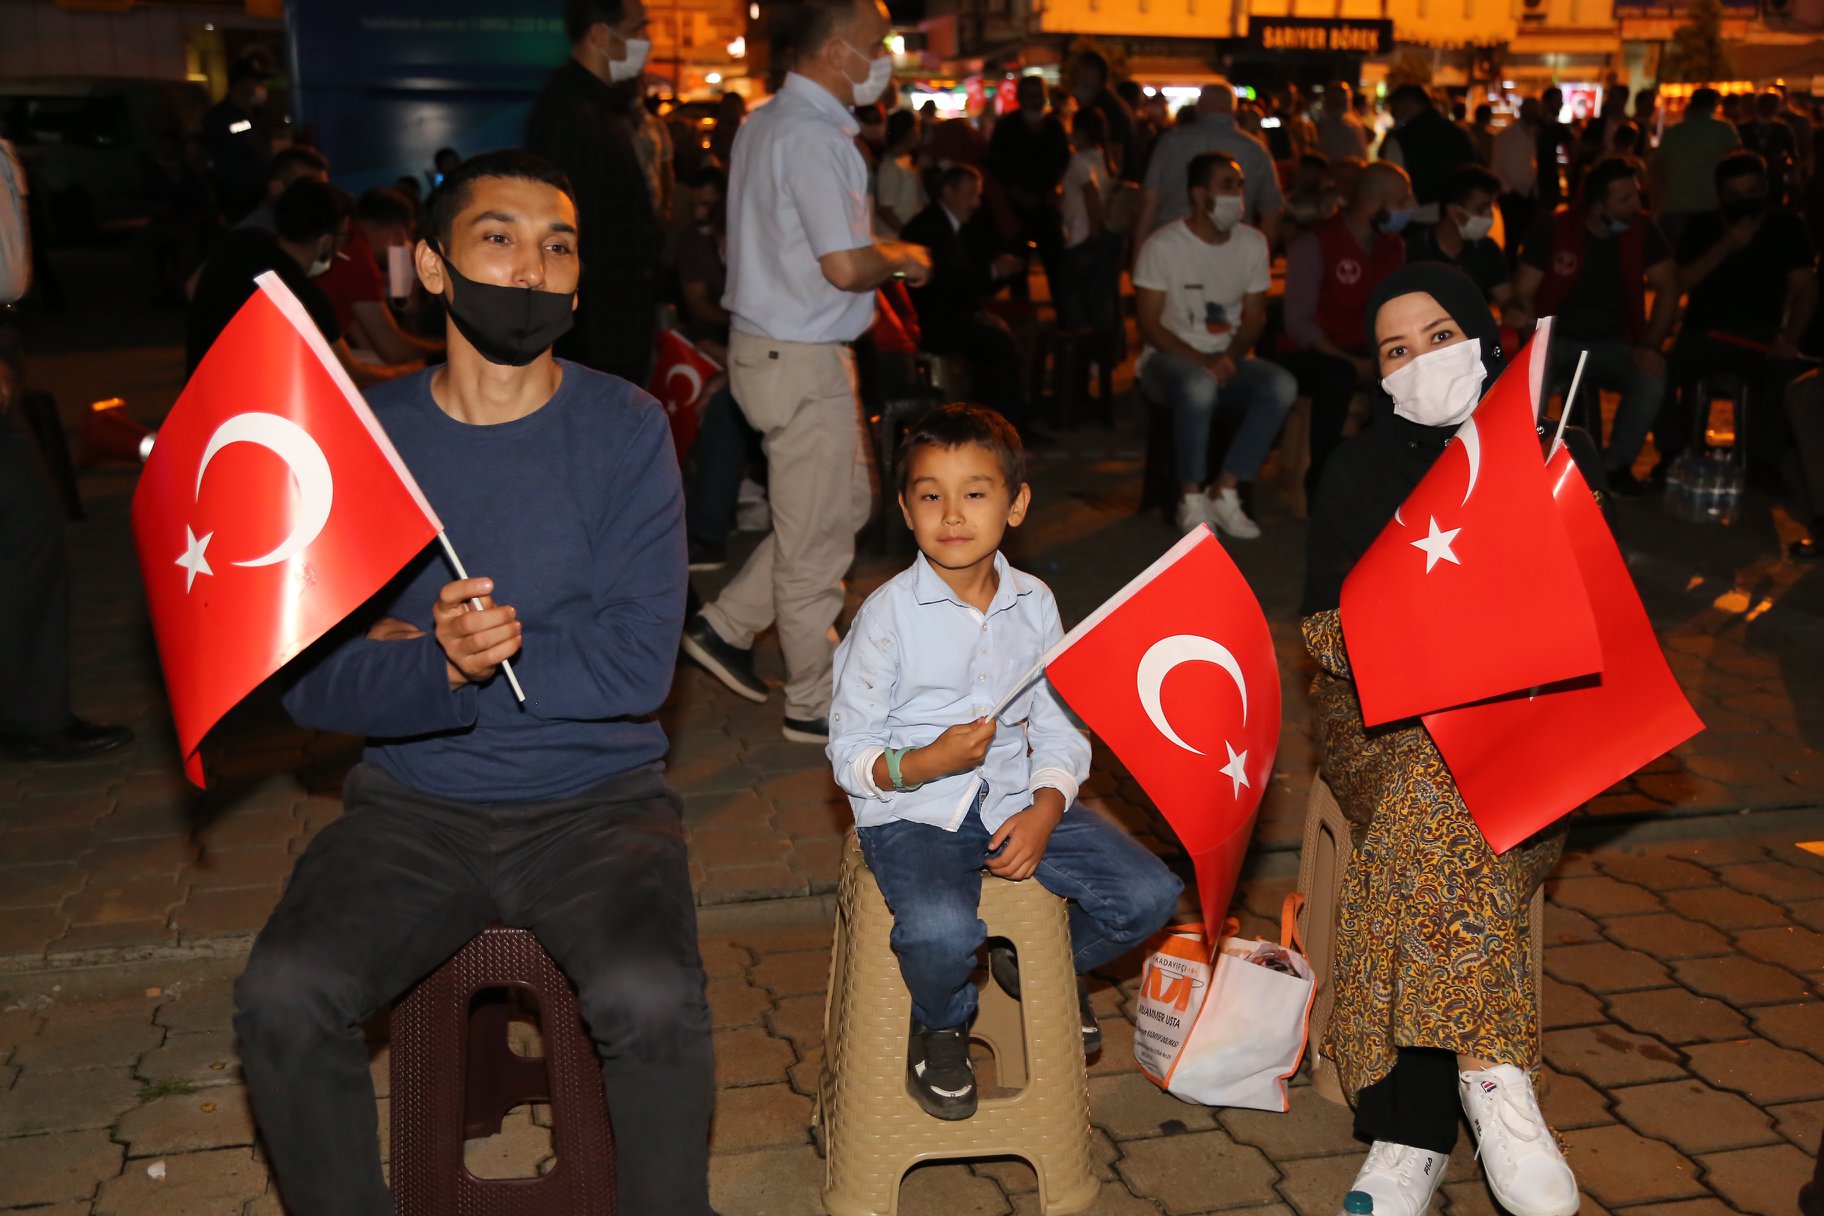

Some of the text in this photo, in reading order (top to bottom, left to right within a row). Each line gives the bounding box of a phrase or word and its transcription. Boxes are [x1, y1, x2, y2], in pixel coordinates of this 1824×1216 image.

[1262, 24, 1379, 51] SARIYER BÖREK
[1165, 1015, 1181, 1029] USTA
[1423, 1157, 1433, 1175] FILA
